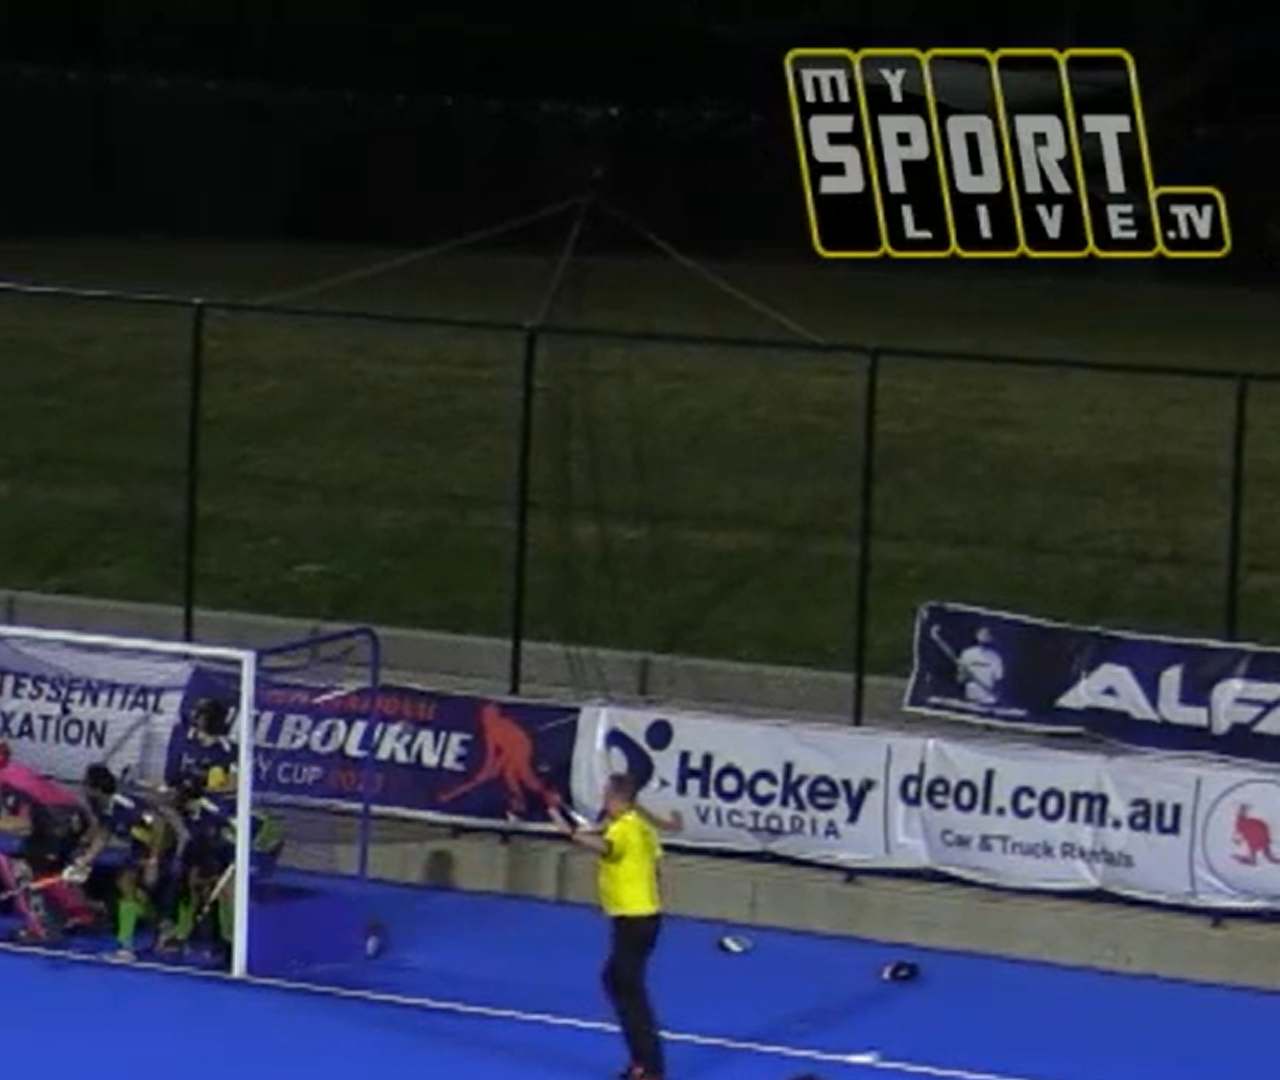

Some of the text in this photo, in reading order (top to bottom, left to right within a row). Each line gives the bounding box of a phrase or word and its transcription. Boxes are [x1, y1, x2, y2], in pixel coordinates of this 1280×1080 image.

[276, 762, 324, 785] CUP
[676, 750, 877, 823] Hockey
[900, 766, 1182, 836] deol.com.au
[693, 803, 842, 840] VICTORIA
[940, 829, 972, 848] Car
[991, 833, 1056, 860] Truck
